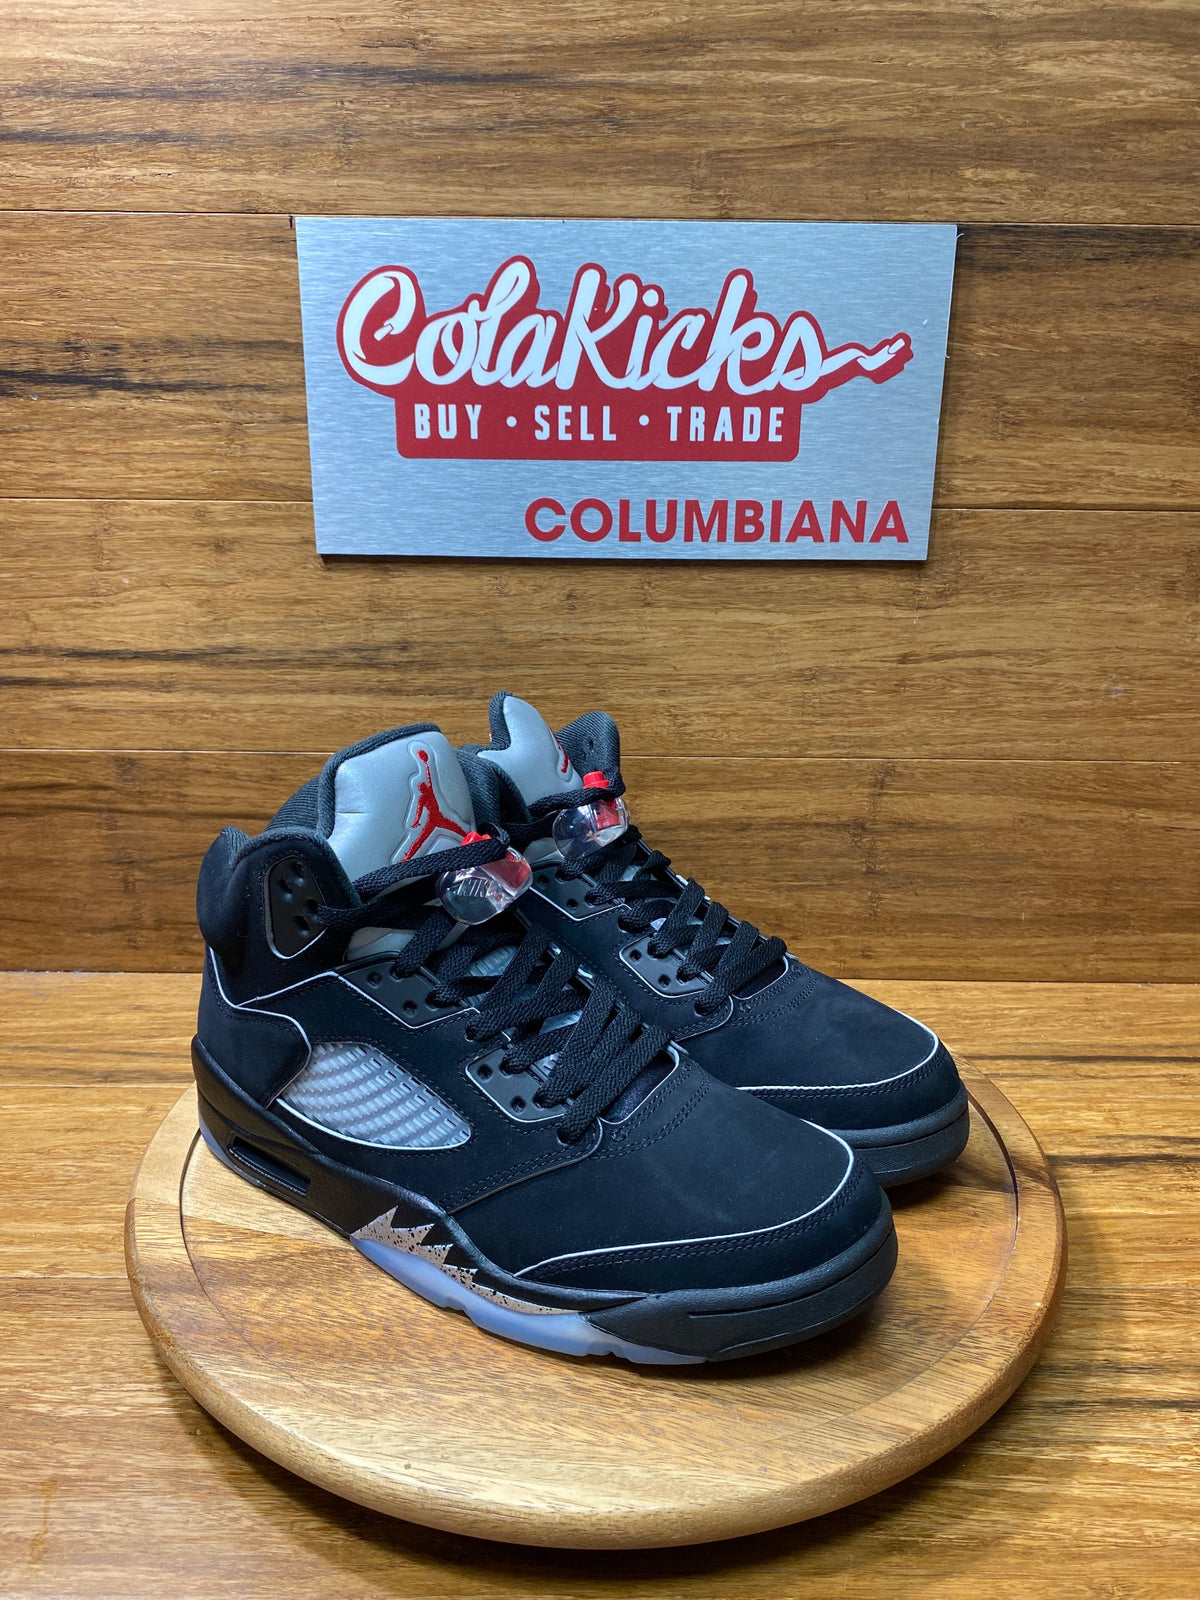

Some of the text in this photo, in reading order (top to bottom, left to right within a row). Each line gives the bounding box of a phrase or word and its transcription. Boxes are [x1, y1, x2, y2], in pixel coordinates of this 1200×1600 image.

[342, 260, 906, 396] ColaKicks
[414, 403, 785, 442] BUY SELL TRADE
[525, 497, 909, 543] COLUMBIANA
